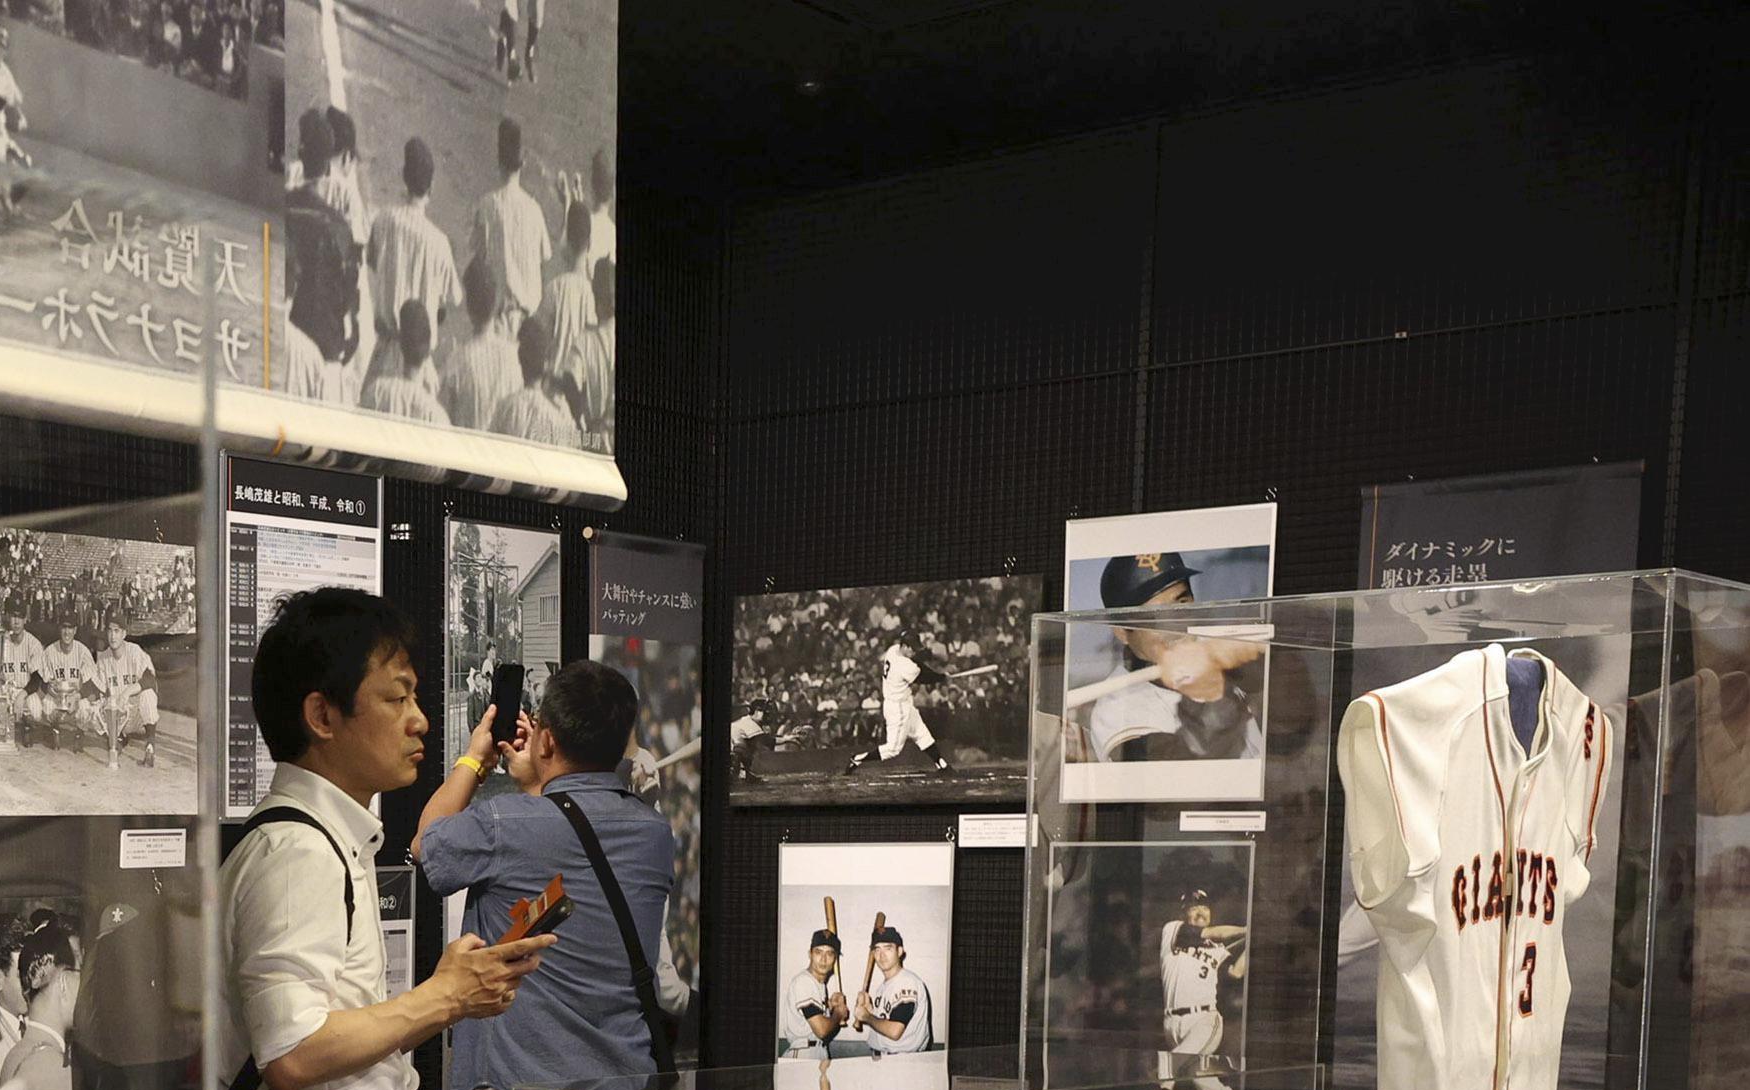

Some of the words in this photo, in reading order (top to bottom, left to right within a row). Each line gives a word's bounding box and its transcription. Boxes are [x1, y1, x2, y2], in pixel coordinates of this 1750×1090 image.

[234, 484, 366, 516] 長嶋茂雄と昭和、平成、令和①
[1382, 537, 1516, 563] ダイナミックに
[602, 581, 697, 610] 大舞台やチャンスに強い
[601, 607, 647, 626] バッティング
[1518, 940, 1538, 1019] 3
